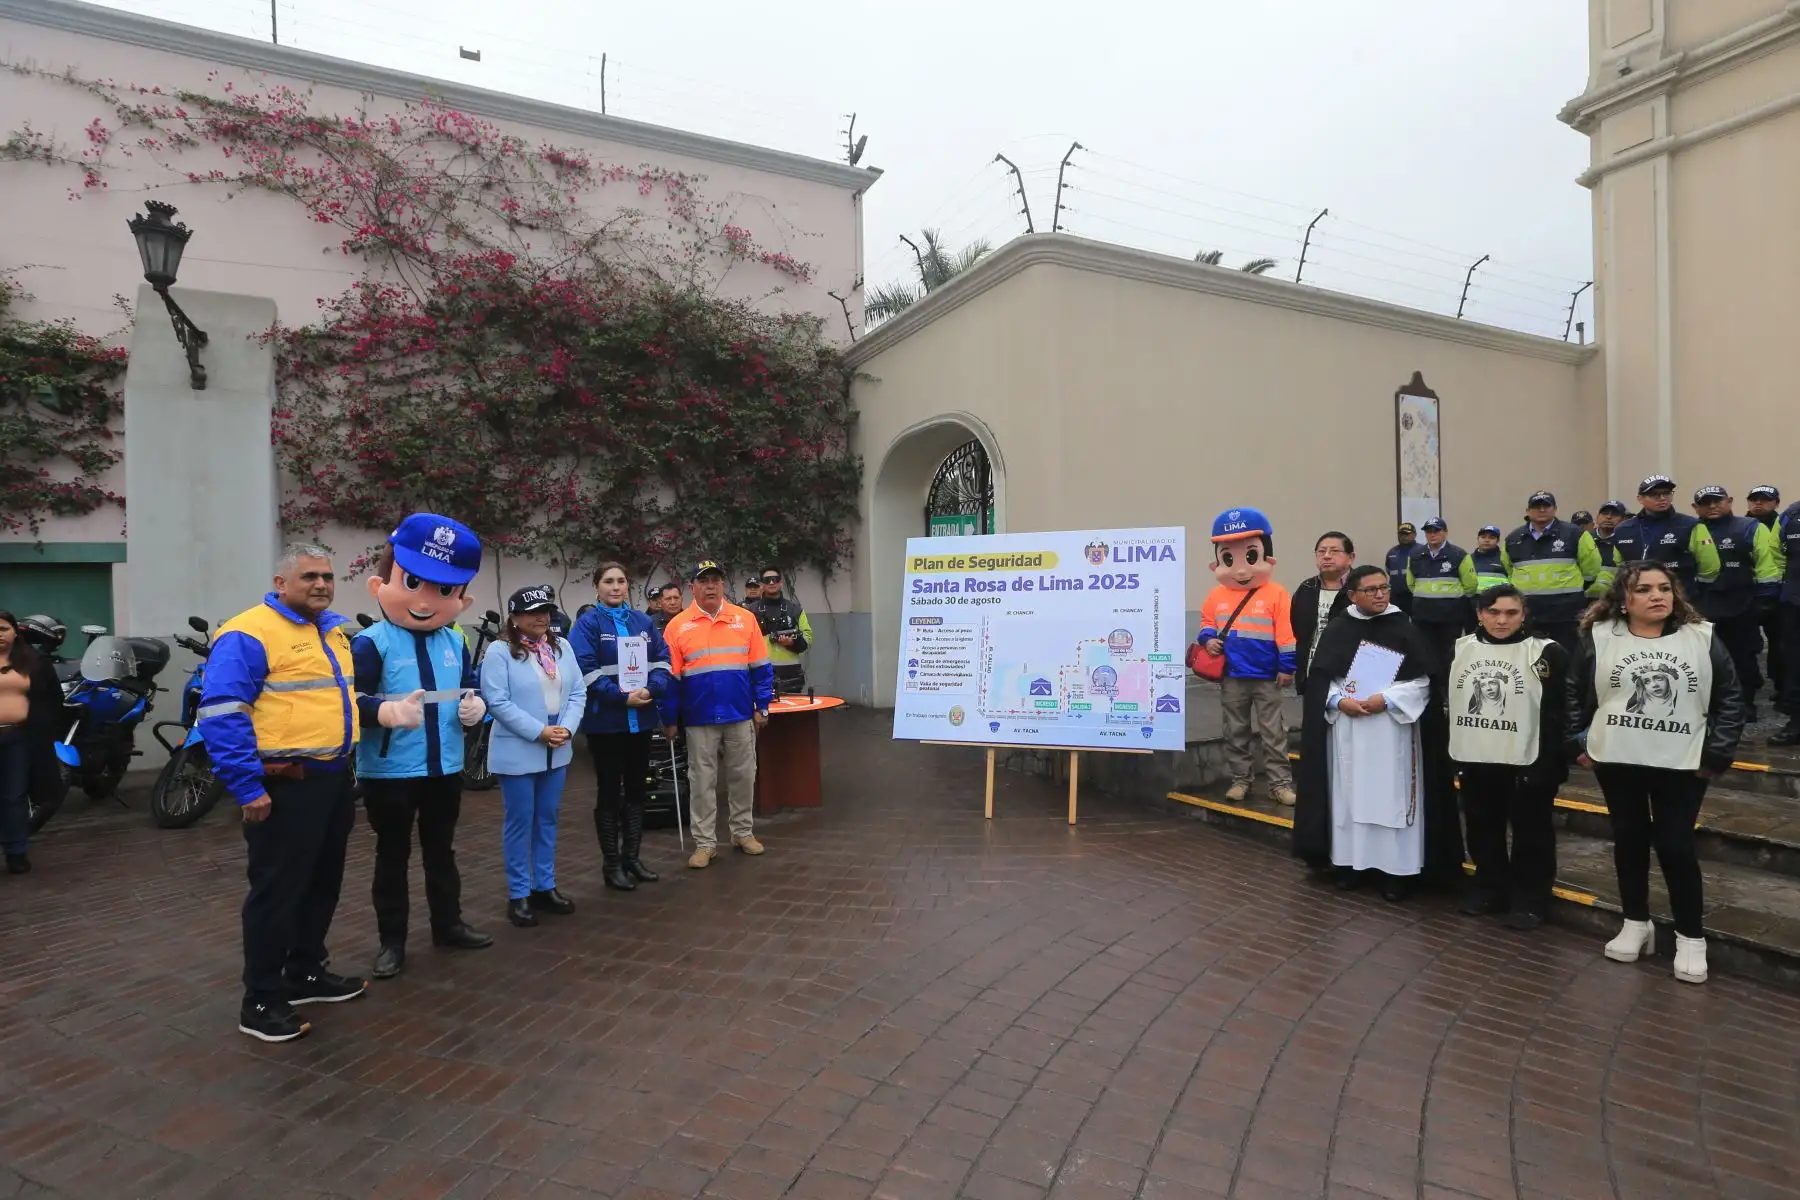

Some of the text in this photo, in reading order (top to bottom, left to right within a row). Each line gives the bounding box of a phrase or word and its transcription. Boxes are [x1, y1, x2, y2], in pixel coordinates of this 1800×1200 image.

[931, 523, 960, 537] ENTRADA
[1224, 522, 1247, 532] LIMA
[421, 546, 450, 564] LIMA
[1113, 544, 1177, 563] LIMA
[914, 554, 1042, 571] Plan de Seguridad
[911, 573, 1140, 594] Santa Rosa de Lima 2025
[911, 596, 1001, 606] Sábado 30 de agosto
[911, 617, 941, 625] LEYENDA
[1456, 659, 1524, 695] ROSA DE SANTA MARIA
[1609, 651, 1698, 693] ROSA DE SANTA MARIA
[1456, 715, 1518, 732] BRIGADA
[1606, 714, 1692, 735] BRIGADA
